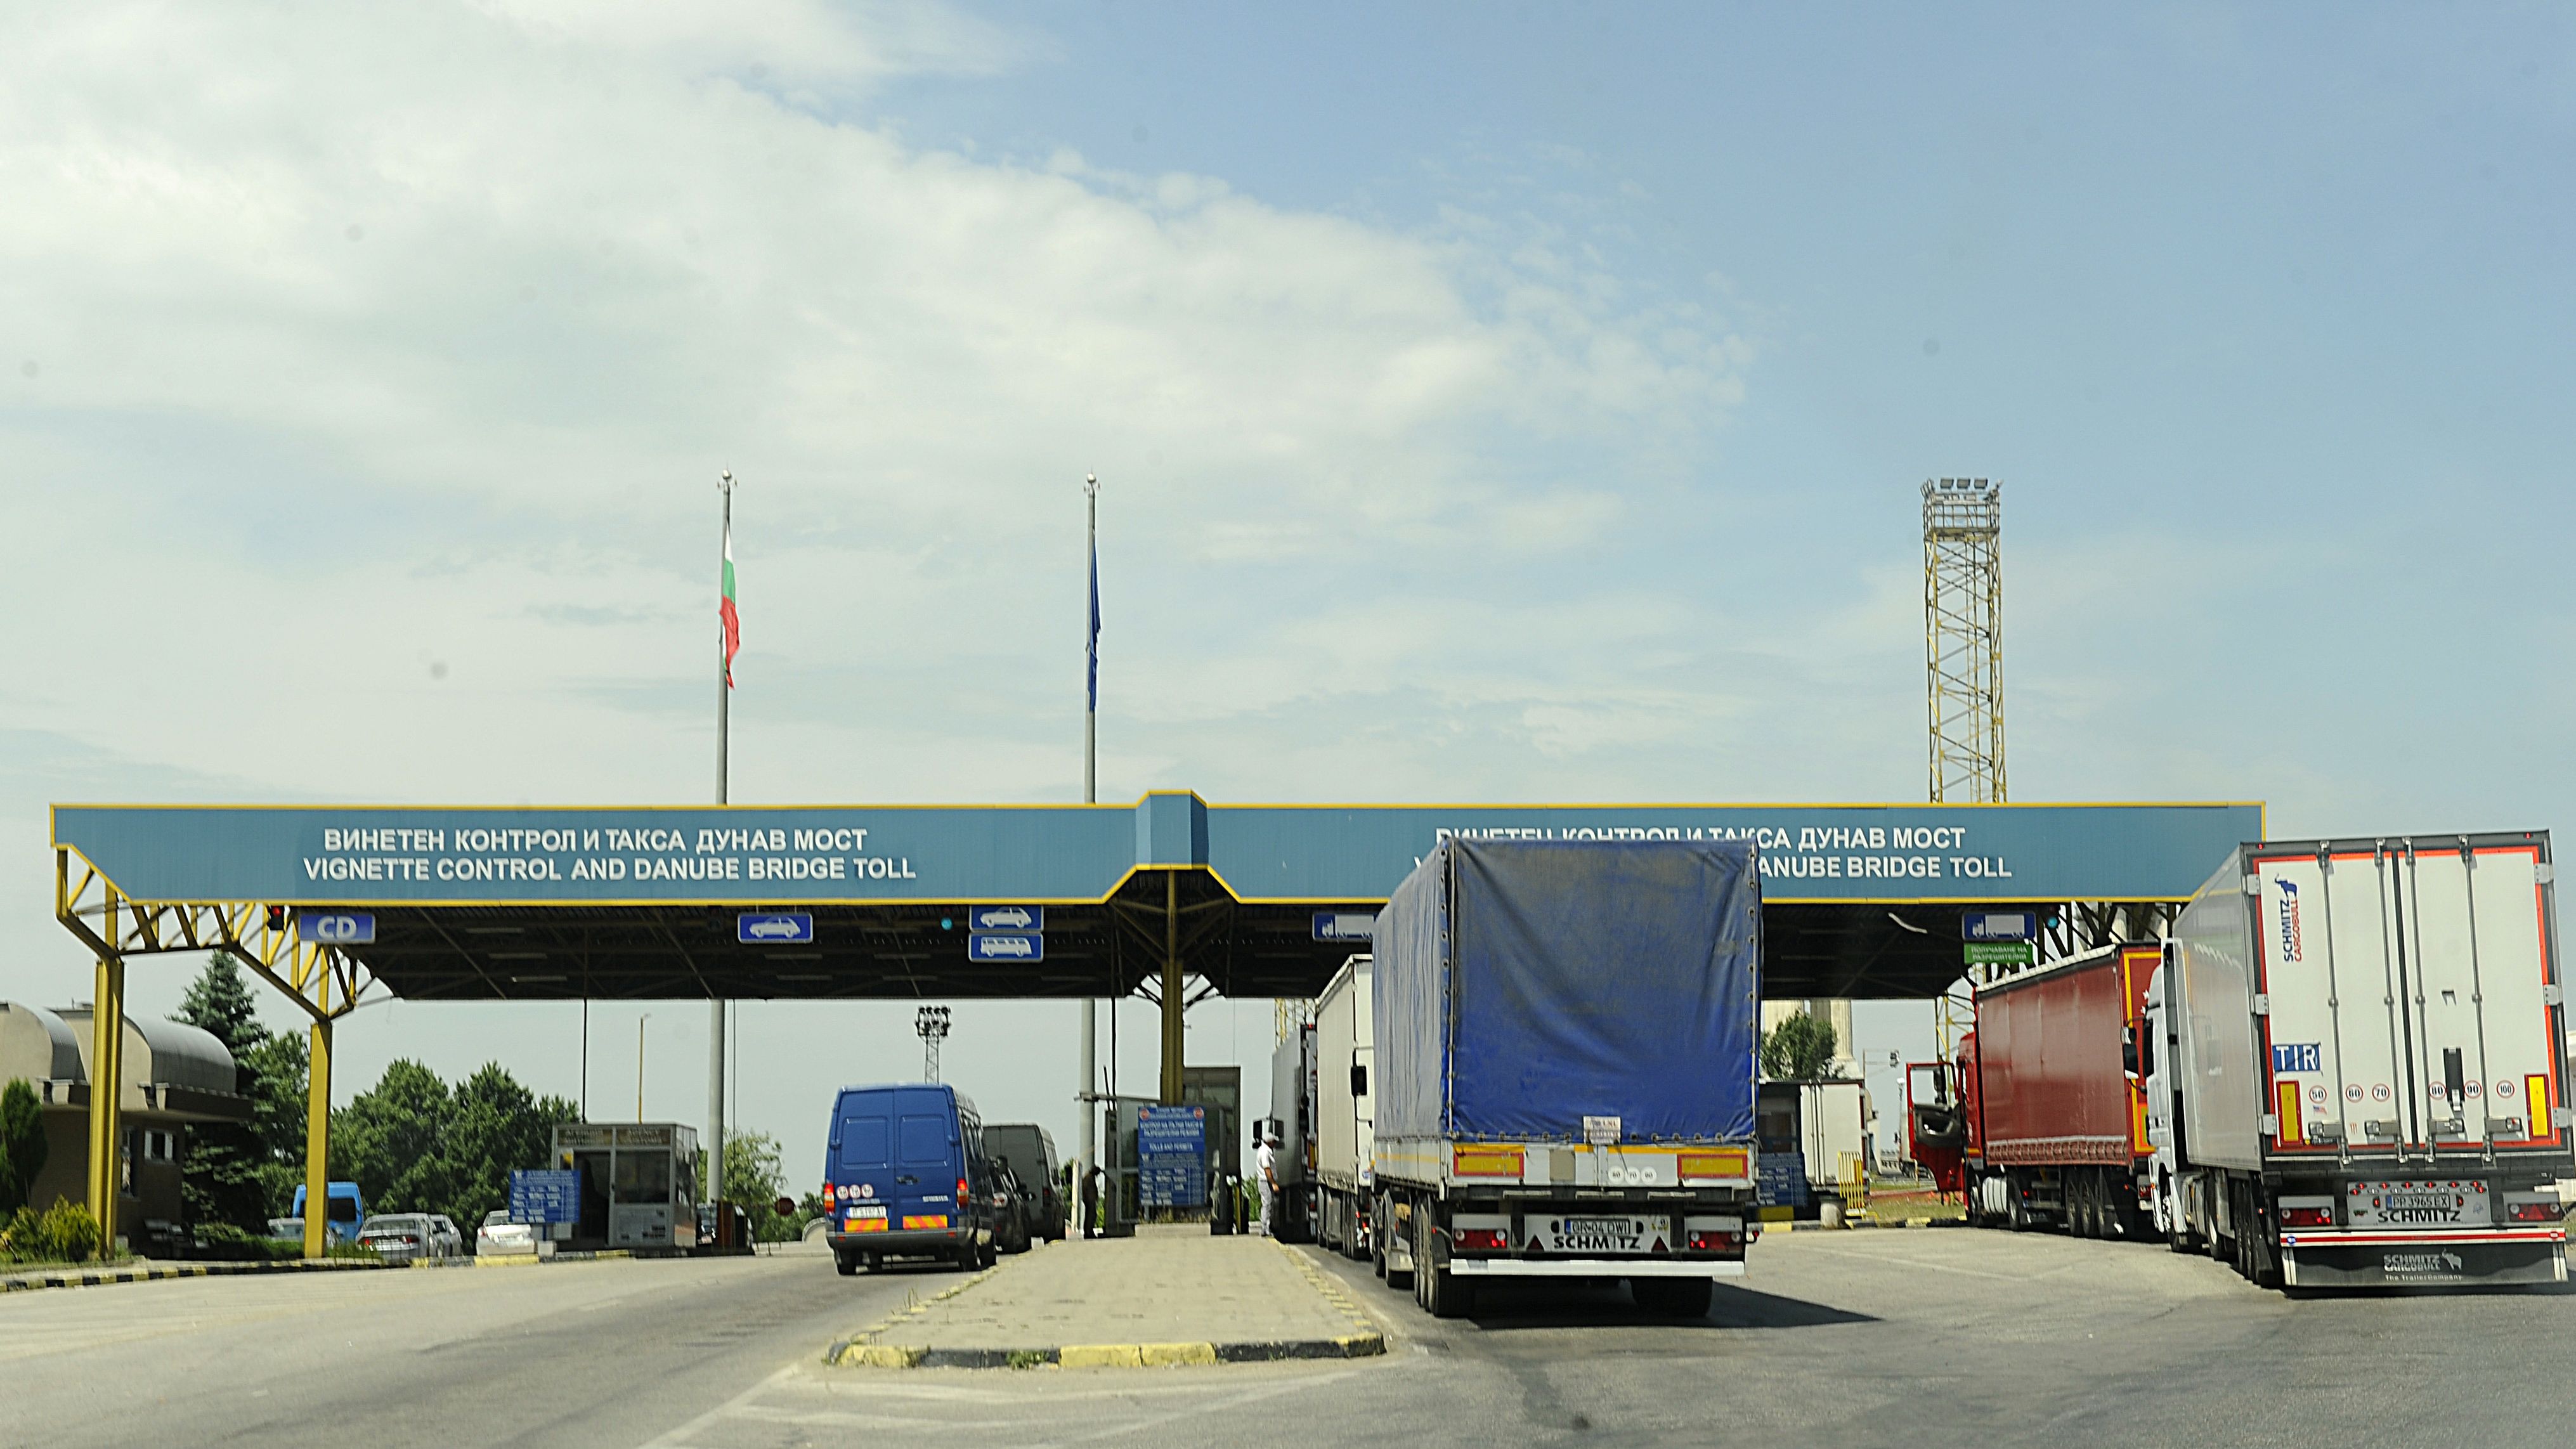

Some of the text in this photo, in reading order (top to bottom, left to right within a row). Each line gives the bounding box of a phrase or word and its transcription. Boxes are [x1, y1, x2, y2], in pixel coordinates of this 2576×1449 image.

[325, 829, 868, 854] ВИНЕТЕН КОНТРОЛ И ТАКСА ДУНАВ МОСТ
[1798, 828, 1886, 853] ДУНАВ
[1893, 828, 1966, 849] МОСТ
[303, 857, 916, 880] VIGNETTE CONTROL AND DANUBE BRIDGE TOLL
[1758, 856, 2012, 878] ANUBE BRIDGE TOLL
[316, 916, 357, 940] CD
[2280, 899, 2294, 962] SCHMITZ
[2275, 1045, 2317, 1071] TIR
[2348, 1088, 2361, 1098] 60
[2375, 1088, 2388, 1098] 70
[2467, 1085, 2480, 1095] 90
[2500, 1085, 2513, 1095] 100
[2378, 1209, 2461, 1223] SCHMITZ
